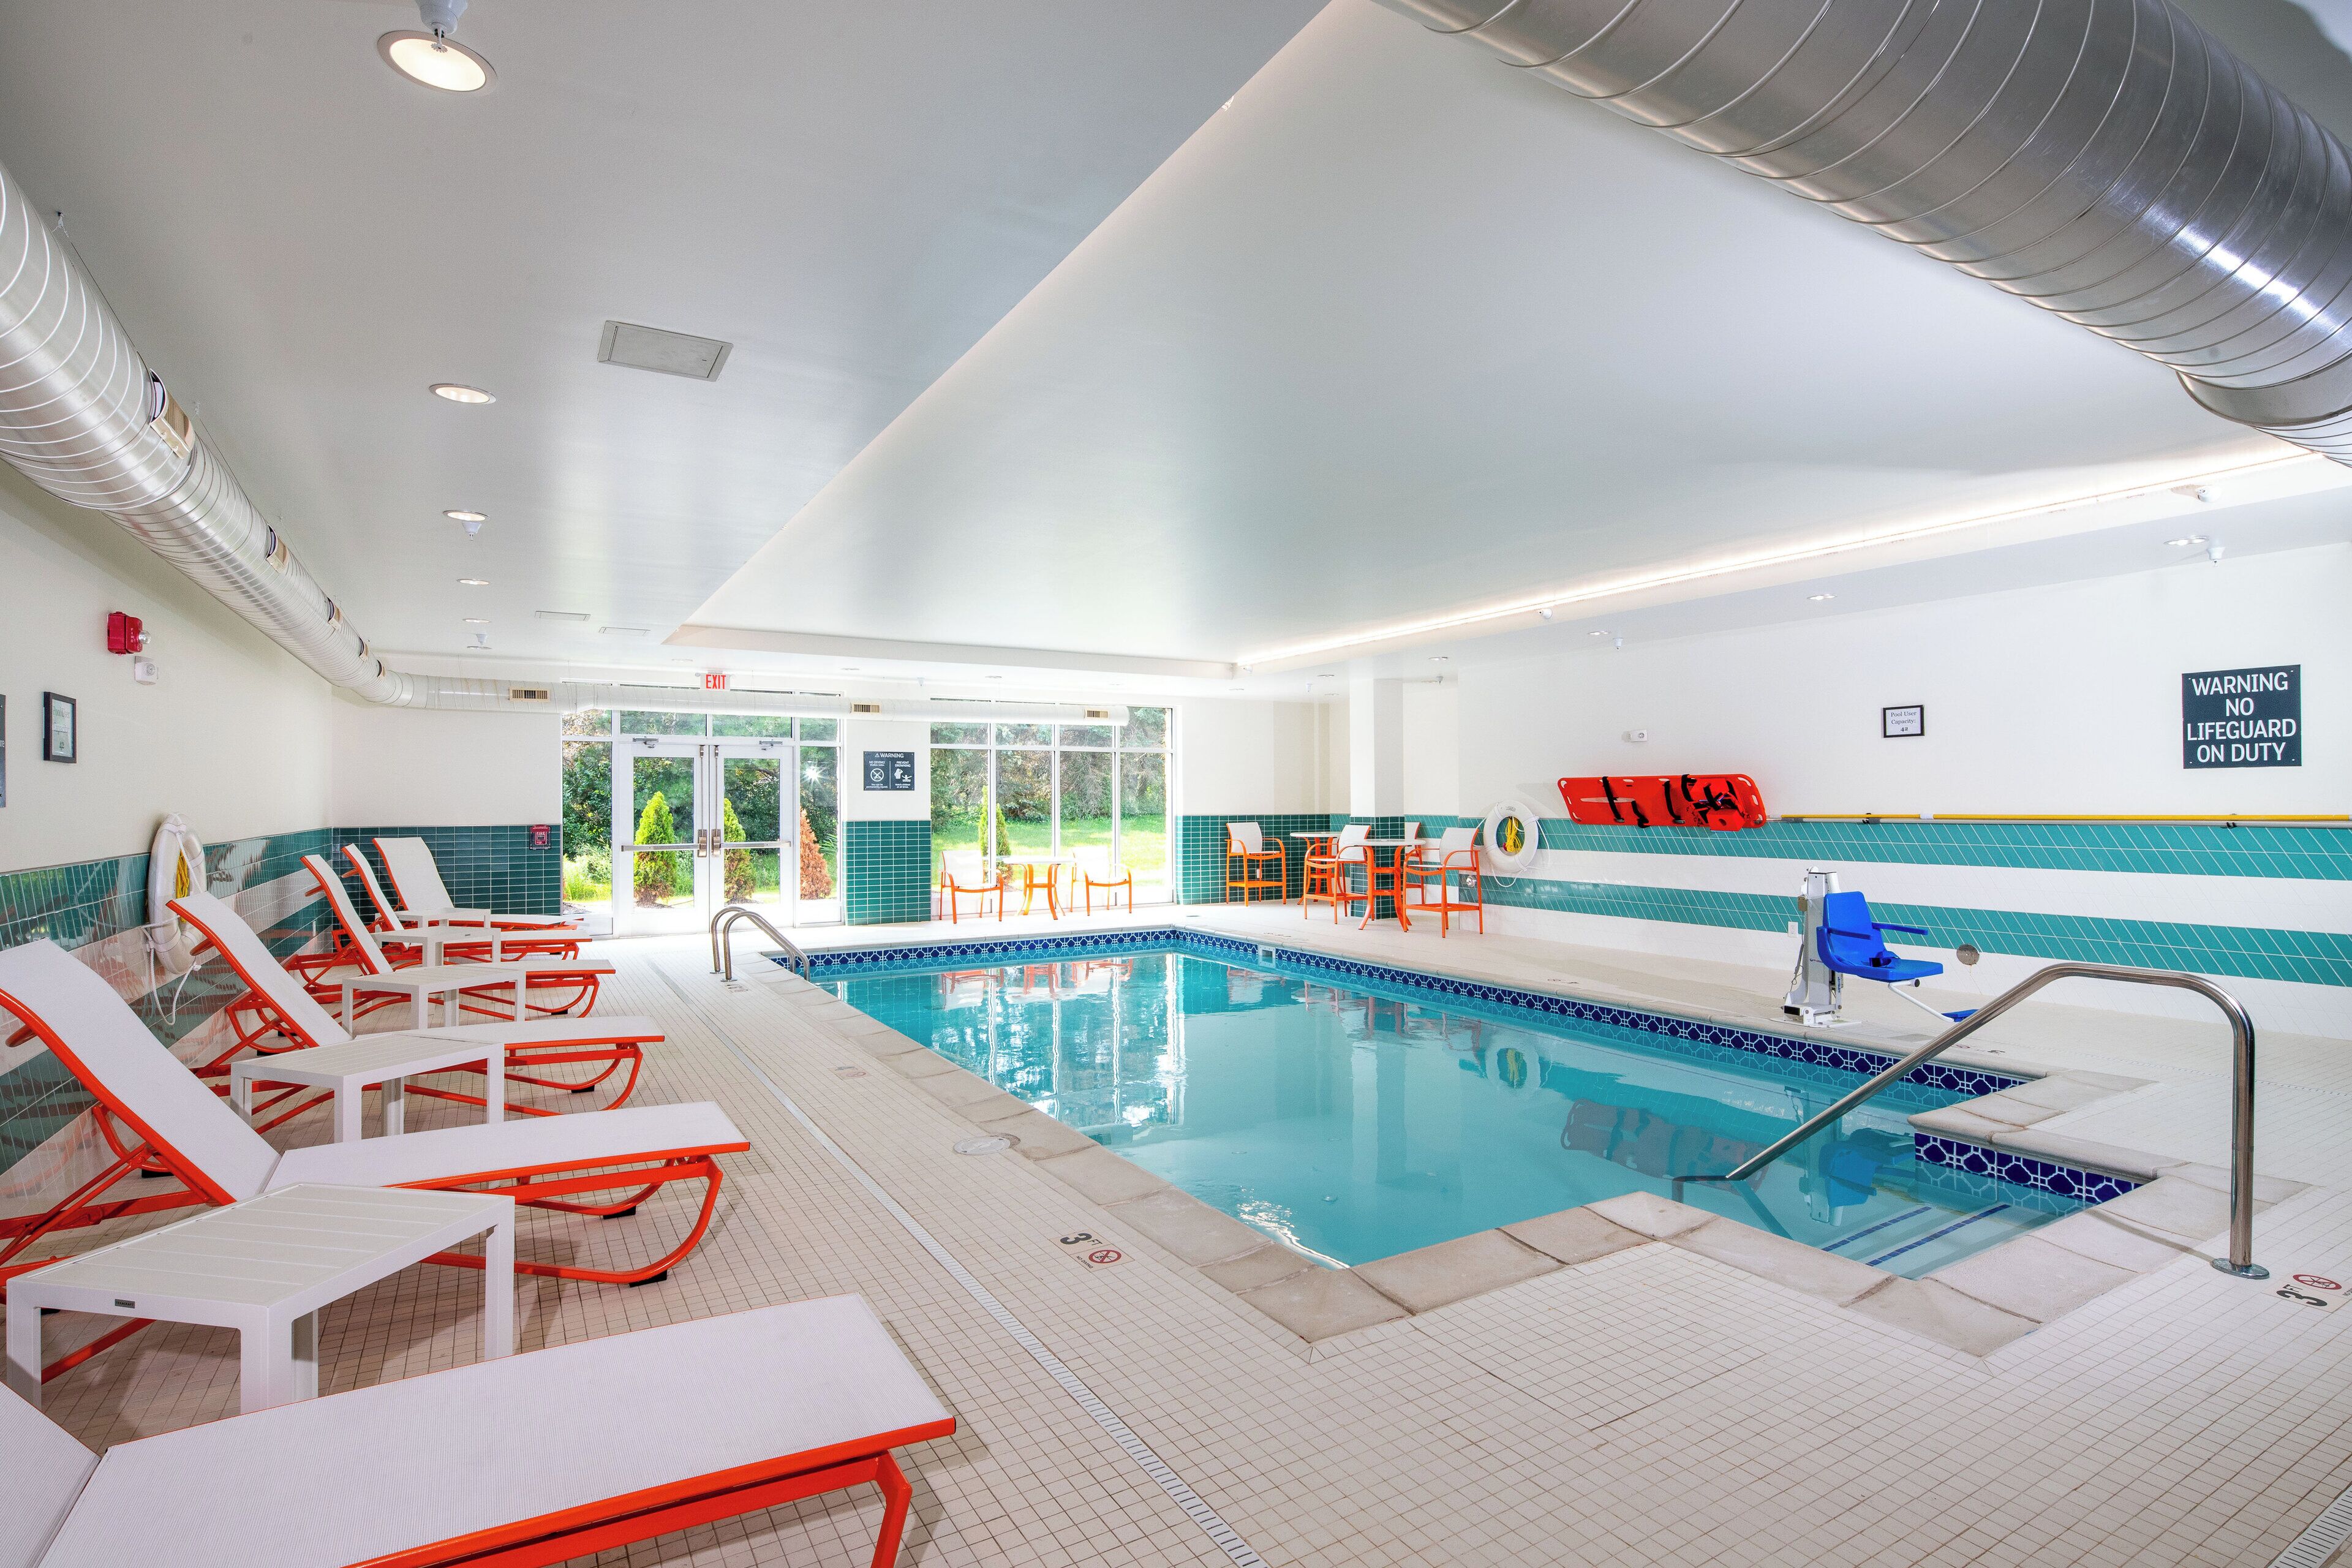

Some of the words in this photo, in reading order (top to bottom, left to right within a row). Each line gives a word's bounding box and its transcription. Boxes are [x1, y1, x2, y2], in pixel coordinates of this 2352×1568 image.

[706, 674, 726, 689] EXIT
[2192, 672, 2288, 696] WARNING
[2225, 697, 2255, 717] NO
[2187, 718, 2296, 741] LIFEGUARD
[2197, 744, 2224, 763] ON
[2231, 742, 2286, 762] DUTY
[1060, 1232, 1093, 1245] 3
[1081, 1259, 1094, 1269] DIVING
[2282, 1284, 2303, 1293] FT
[2276, 1290, 2328, 1306] 3
